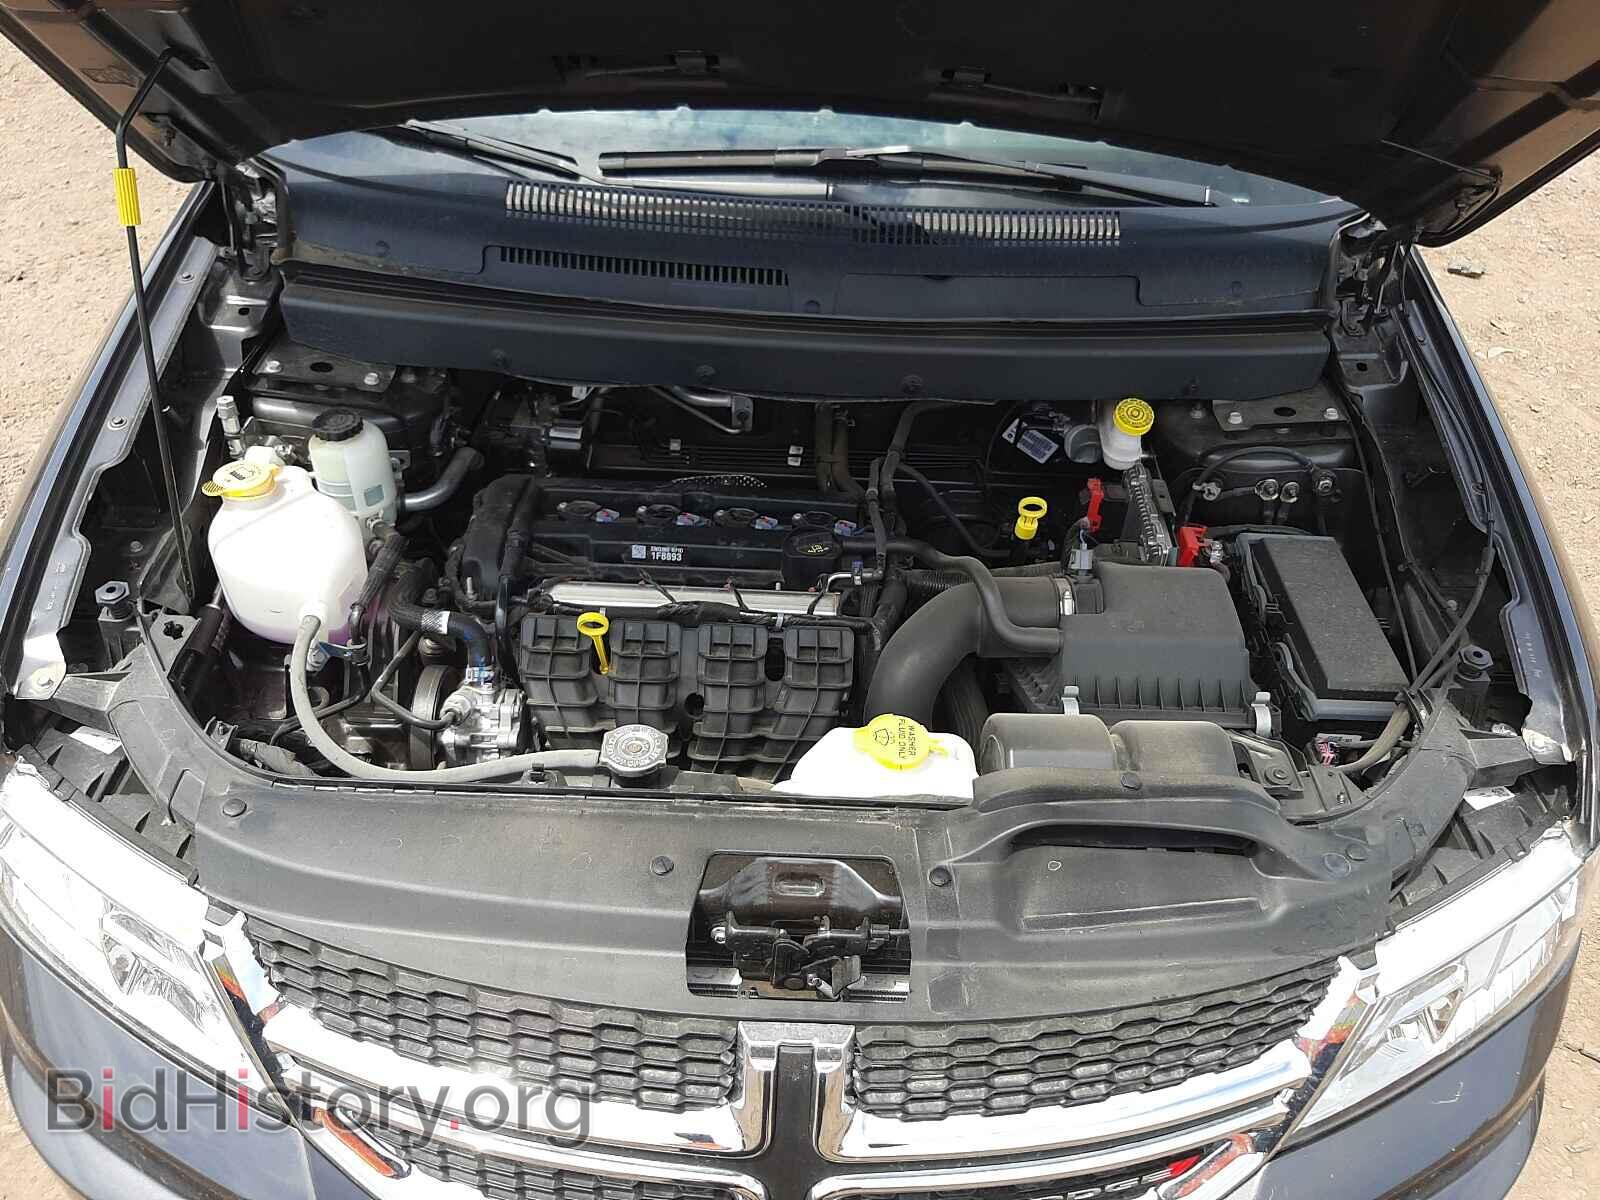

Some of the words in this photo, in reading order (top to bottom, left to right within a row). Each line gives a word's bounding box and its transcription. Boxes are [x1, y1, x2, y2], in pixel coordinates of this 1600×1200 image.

[898, 718, 906, 739] FLUID
[898, 741, 906, 760] ONLY
[907, 725, 917, 757] WASHER
